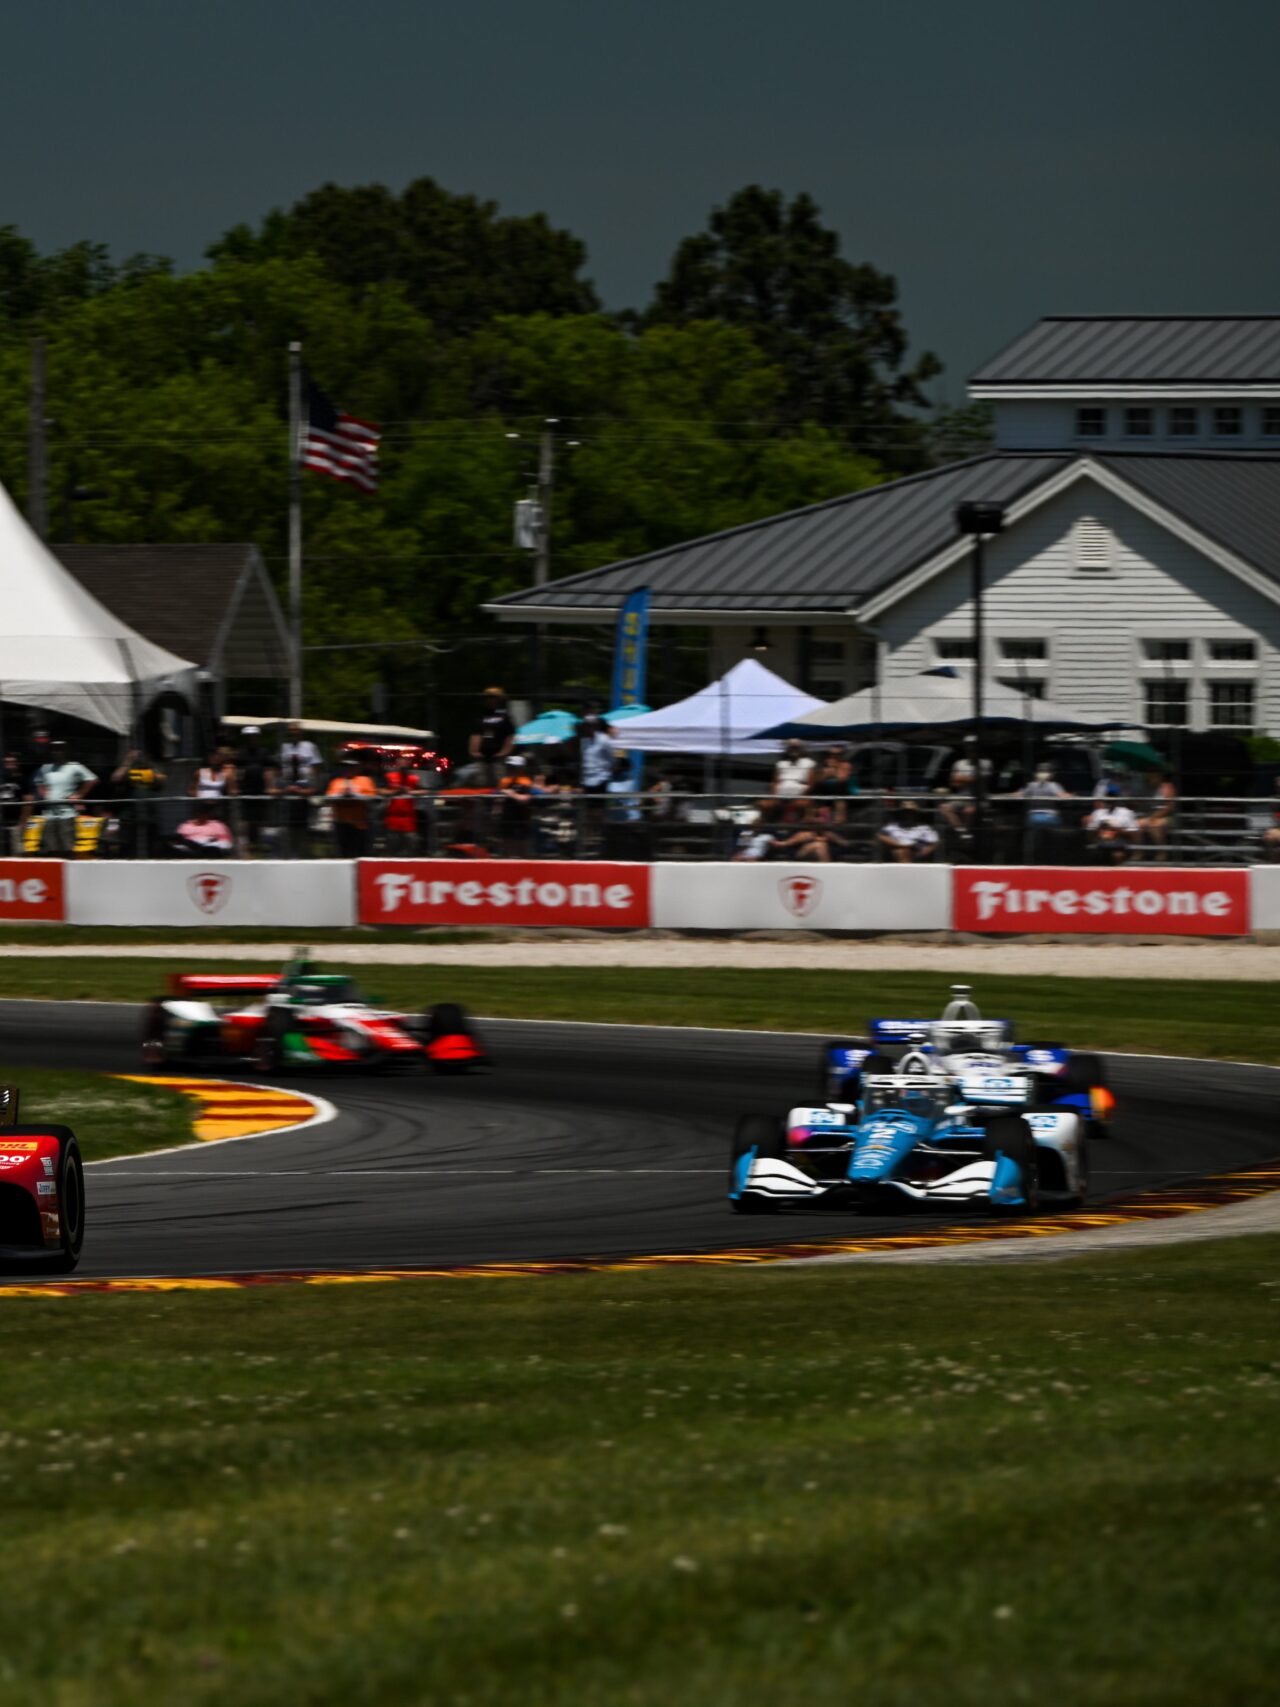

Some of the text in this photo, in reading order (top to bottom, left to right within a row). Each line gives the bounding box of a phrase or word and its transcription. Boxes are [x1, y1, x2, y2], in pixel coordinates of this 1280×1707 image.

[375, 872, 633, 912] Firestone
[970, 880, 1232, 920] Firestone
[869, 1128, 897, 1139] 2
